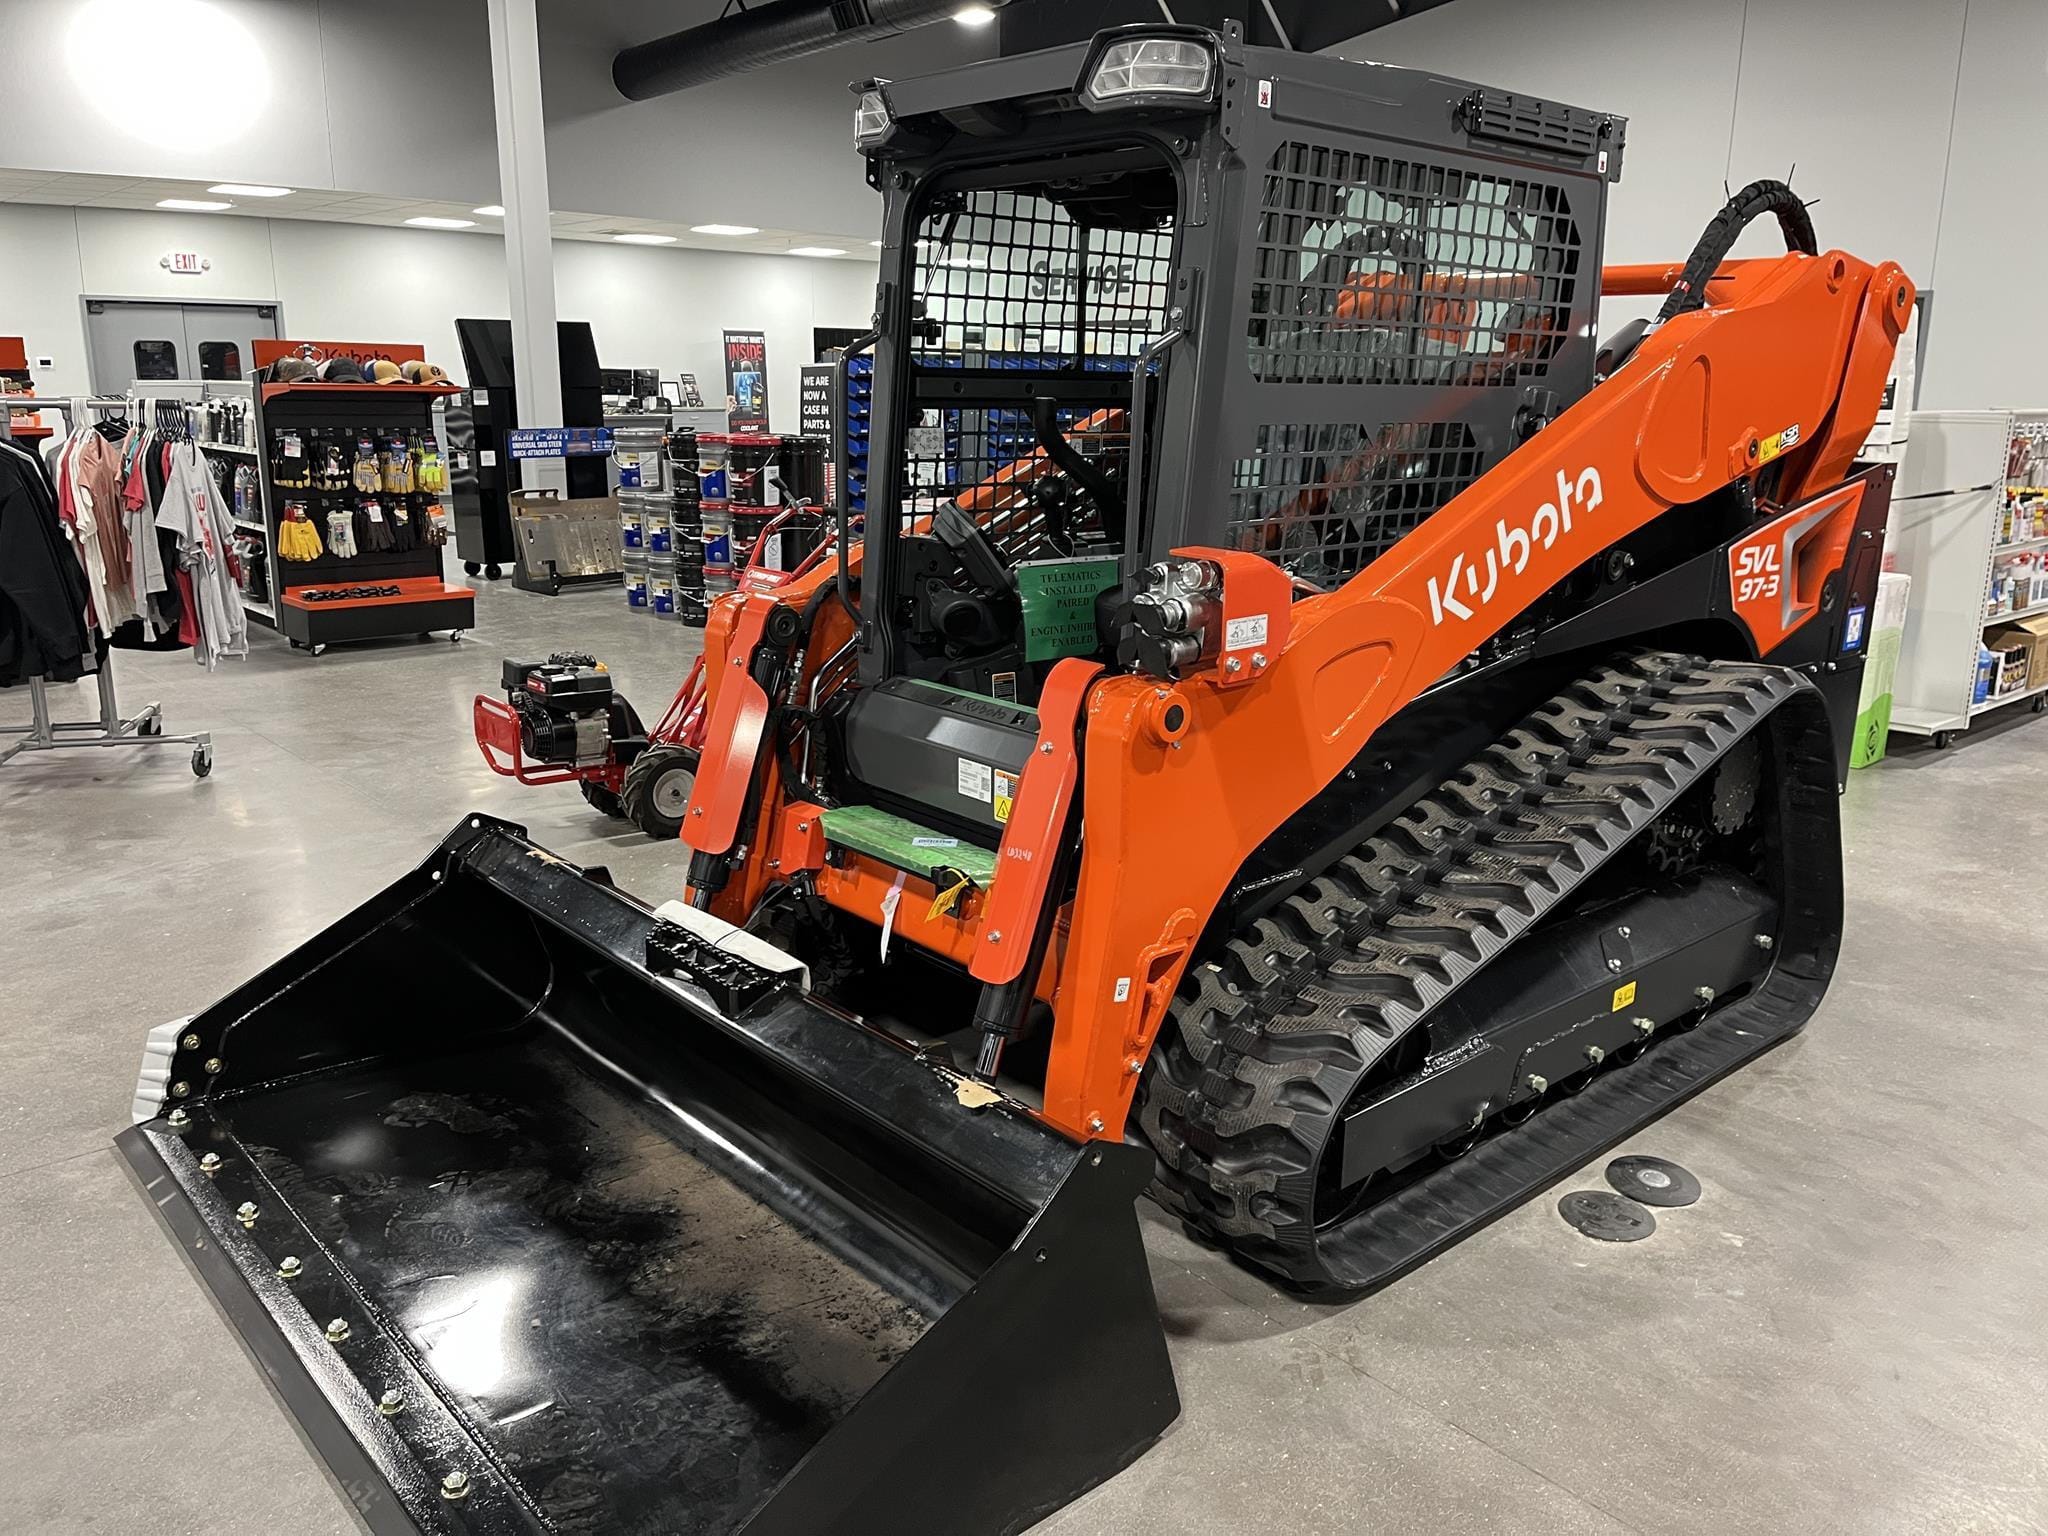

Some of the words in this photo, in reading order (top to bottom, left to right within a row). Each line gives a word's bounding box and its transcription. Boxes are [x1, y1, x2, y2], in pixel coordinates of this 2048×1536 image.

[175, 253, 197, 270] EXIT
[728, 343, 764, 361] INSIDE
[803, 376, 815, 386] WE
[815, 375, 830, 386] ARE
[803, 390, 821, 401] NOW
[821, 390, 828, 401] A
[803, 404, 821, 415] CASE
[821, 404, 829, 415] IH
[803, 419, 824, 430] PARTS
[824, 419, 831, 430] &
[1780, 424, 1800, 444] KSR
[512, 441, 537, 450] UNIVERSAL
[537, 441, 548, 449] SKID
[548, 440, 563, 449] STEER
[512, 449, 545, 457] QUICK-ATTACH
[545, 448, 562, 456] PLATES
[1426, 466, 1604, 627] Kubota
[1734, 544, 1780, 577] SVL
[1039, 570, 1102, 584] TELEMATICS
[1044, 583, 1098, 596] INSTALLED,
[1737, 574, 1780, 602] 97-3
[1056, 596, 1090, 609] PAIRED
[1069, 611, 1076, 620] &
[1031, 624, 1066, 637] ENGINE
[1051, 635, 1094, 648] ENABLED
[962, 699, 1007, 720] Kubota
